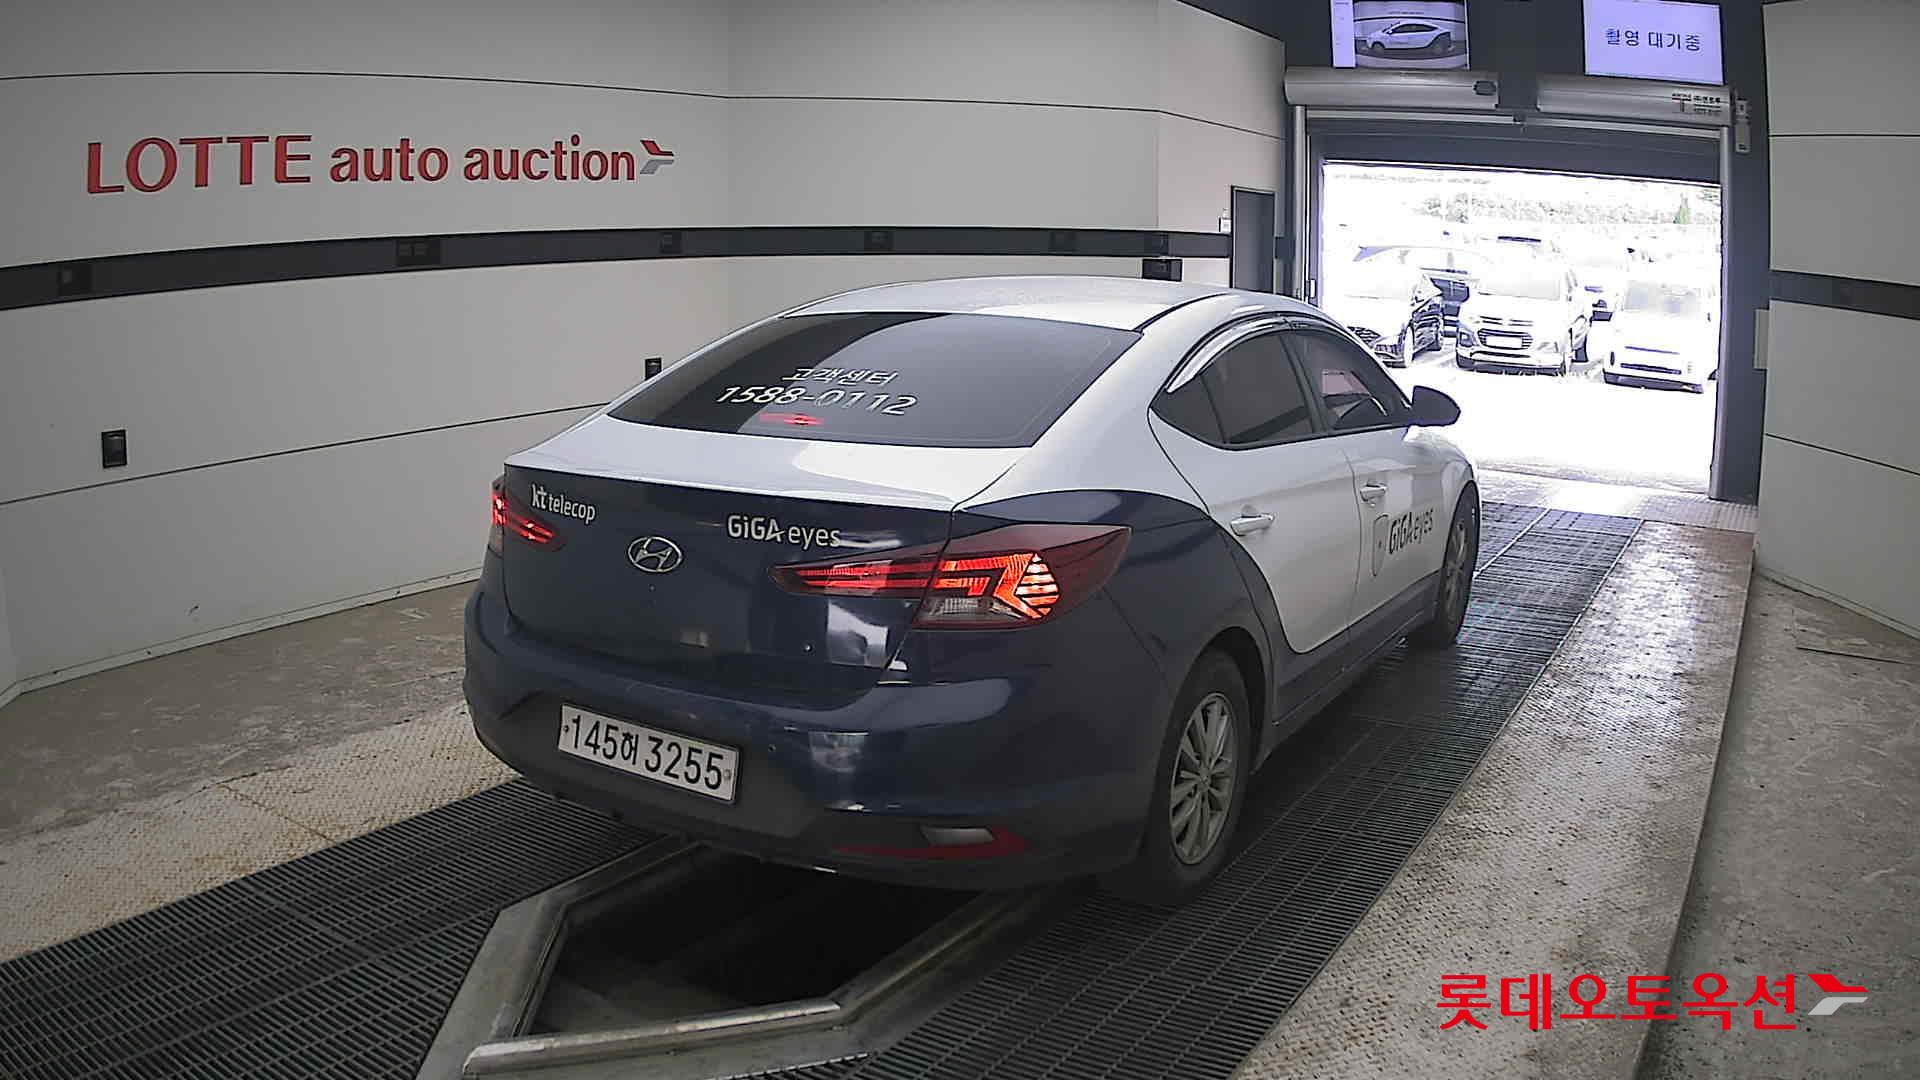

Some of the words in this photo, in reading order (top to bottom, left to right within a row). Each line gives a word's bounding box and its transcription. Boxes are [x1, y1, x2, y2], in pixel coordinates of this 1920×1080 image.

[1647, 31, 1700, 52] 대기중
[87, 135, 312, 194] LOTTE
[329, 137, 449, 181] auto
[463, 134, 636, 181] auction
[782, 368, 898, 387] 고객센터
[716, 386, 917, 416] 1588-0112
[532, 483, 547, 509] kt
[548, 493, 596, 525] telecop
[727, 514, 785, 543] GiGA
[787, 525, 841, 550] eyes
[644, 735, 724, 790] 3255
